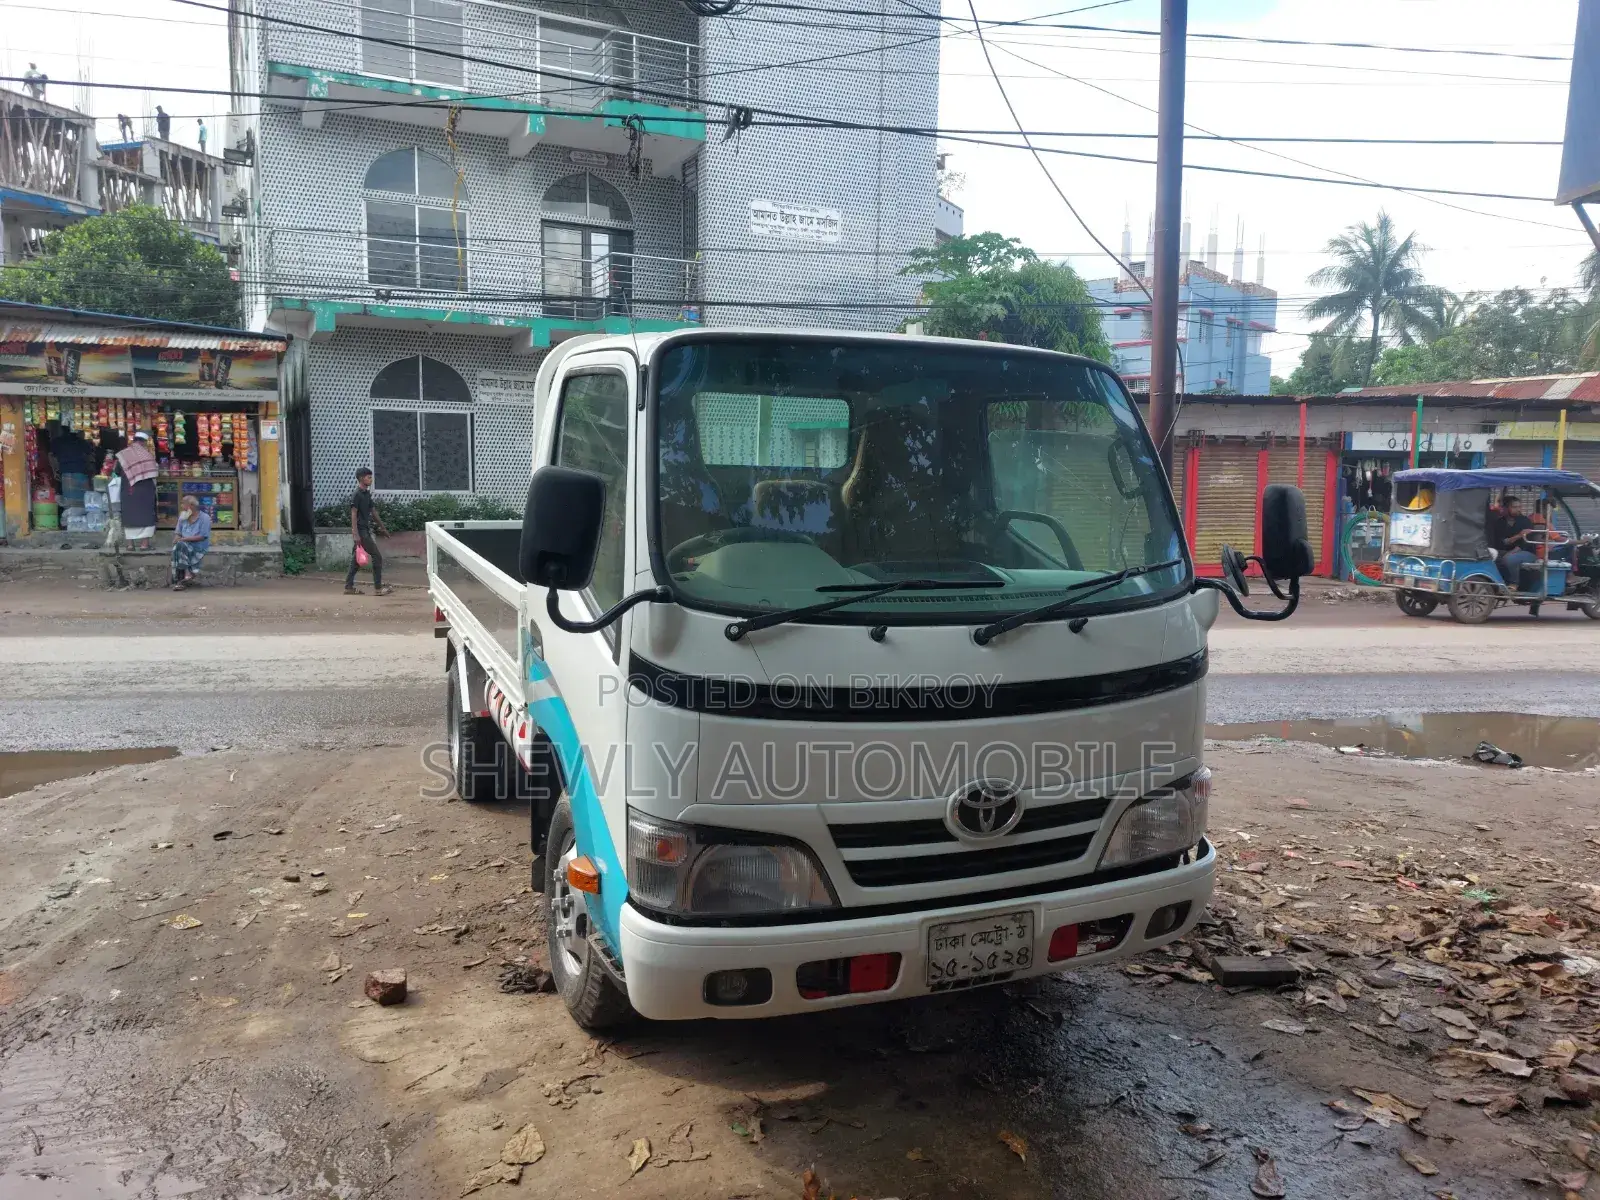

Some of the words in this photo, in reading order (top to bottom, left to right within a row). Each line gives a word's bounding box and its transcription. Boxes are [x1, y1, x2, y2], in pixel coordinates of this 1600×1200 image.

[799, 214, 815, 227] জামে
[816, 215, 838, 229] মসজিদ
[934, 934, 967, 951] ঢাকা
[930, 946, 1029, 980] ১৫-১৫২৪
